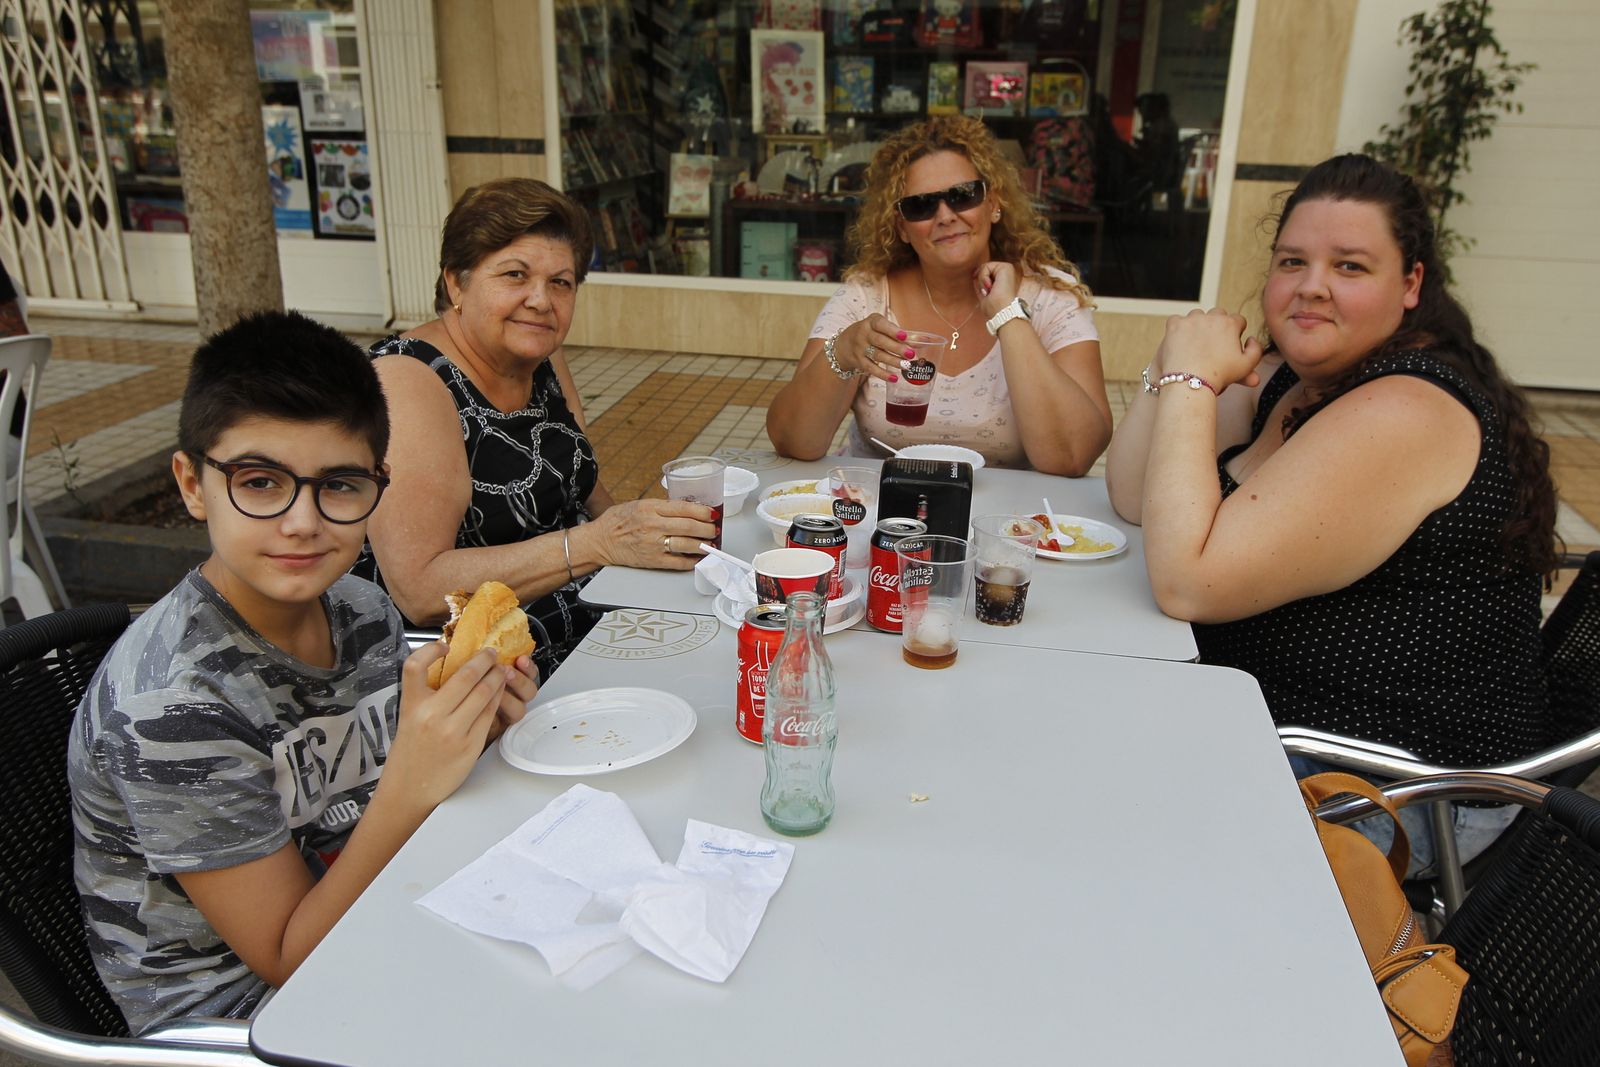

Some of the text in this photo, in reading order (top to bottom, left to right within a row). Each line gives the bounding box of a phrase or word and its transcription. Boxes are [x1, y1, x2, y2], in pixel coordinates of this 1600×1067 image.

[907, 372, 931, 380] Galicia
[835, 503, 862, 513] Estrella
[836, 510, 861, 520] Galicia
